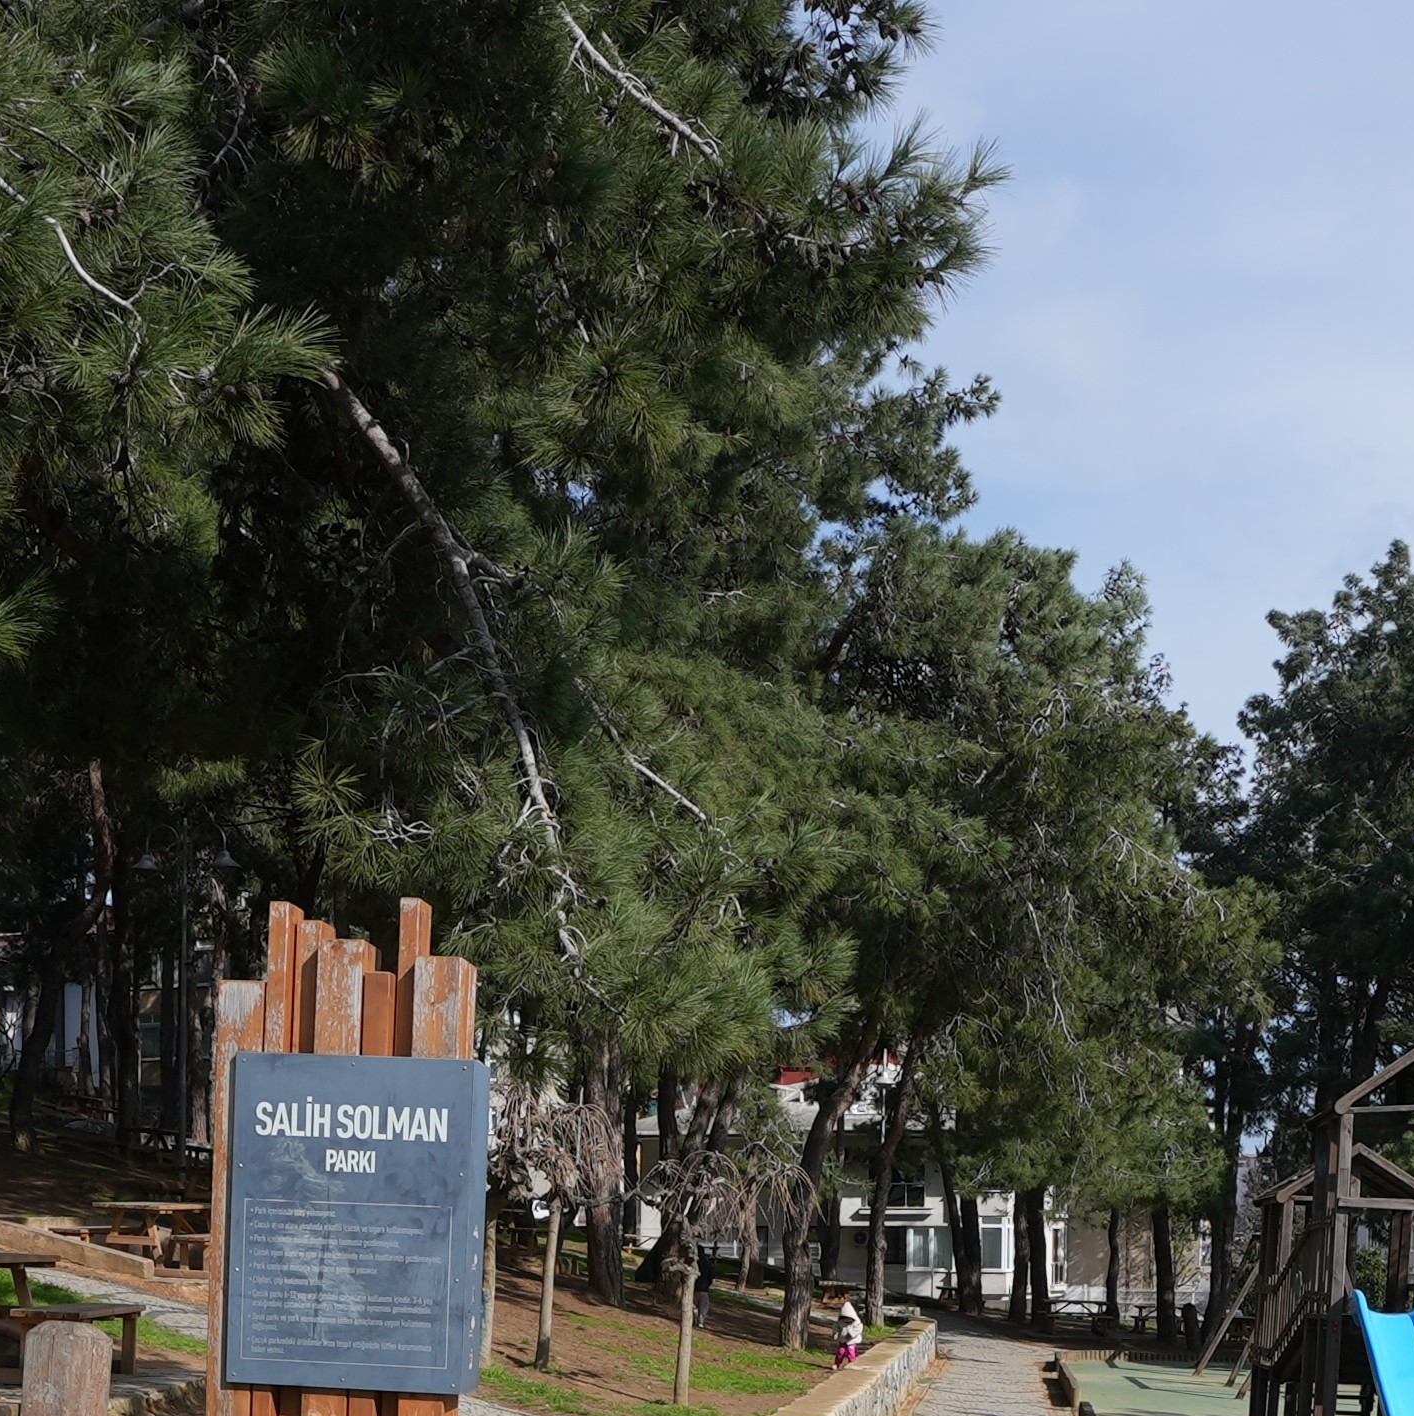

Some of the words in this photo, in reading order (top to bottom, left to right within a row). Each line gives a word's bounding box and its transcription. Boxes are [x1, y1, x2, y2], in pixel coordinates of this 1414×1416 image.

[255, 1095, 331, 1138] SALİH
[337, 1104, 448, 1142] SOLMAN
[325, 1149, 376, 1173] PARKI
